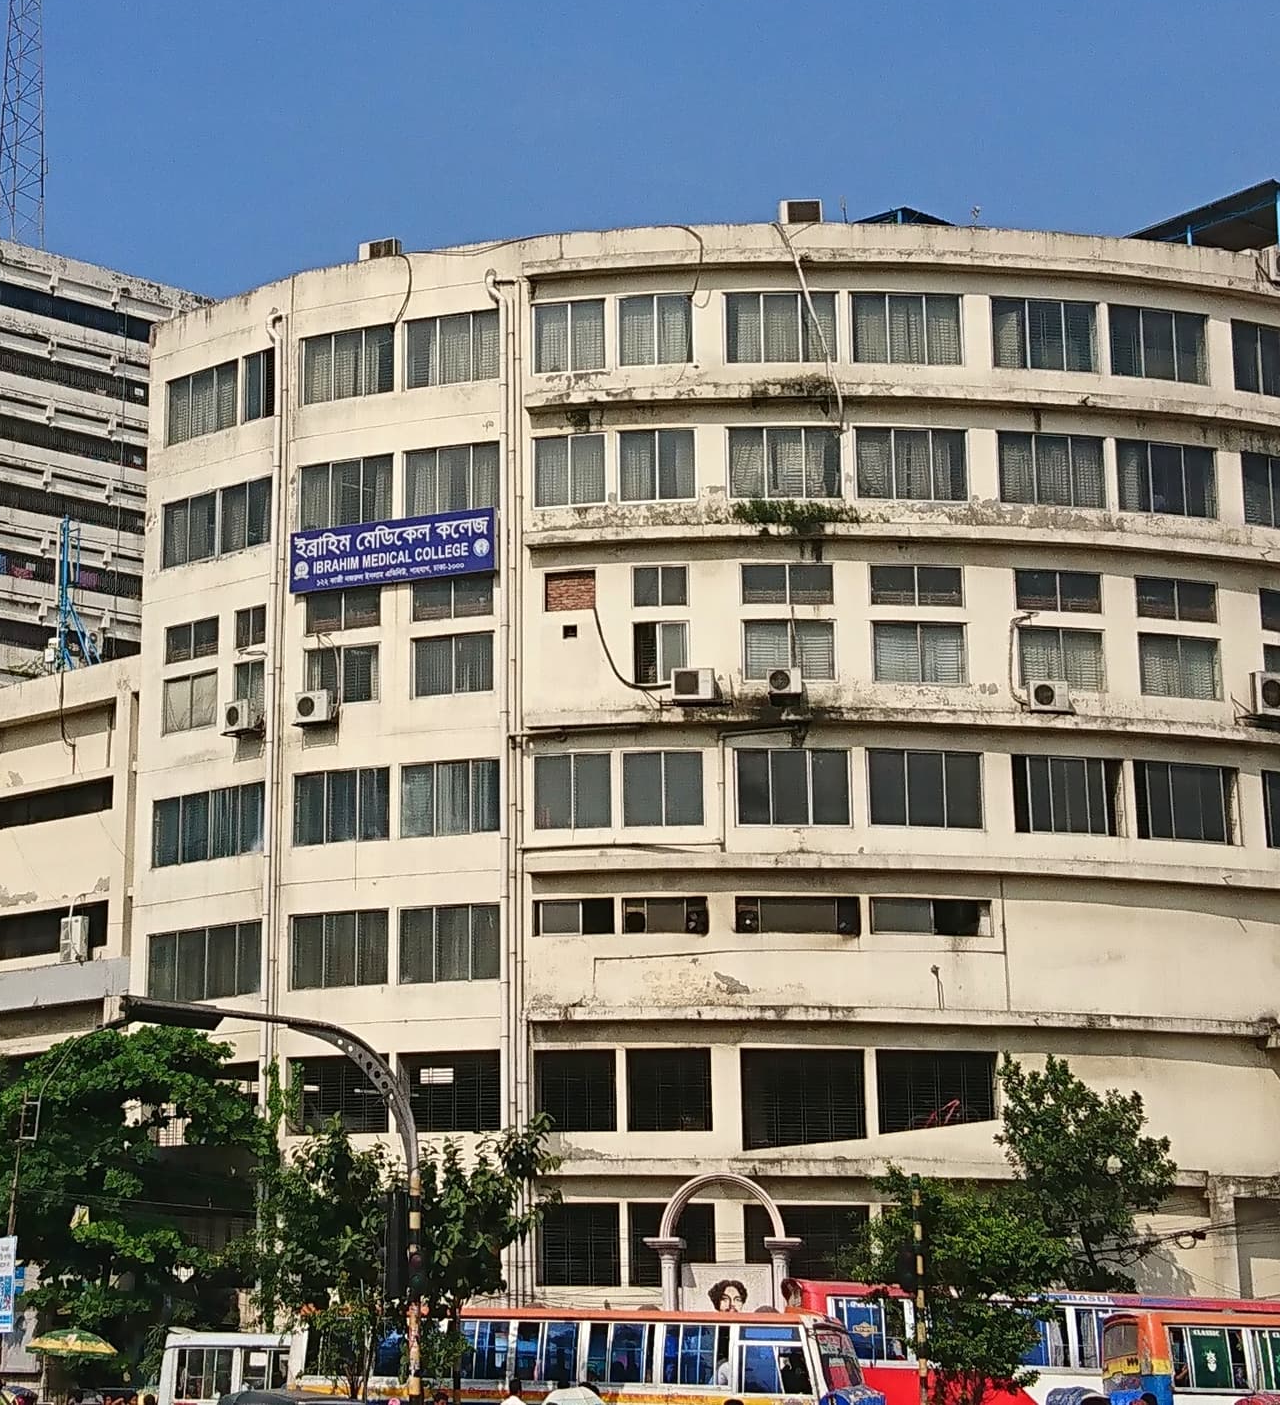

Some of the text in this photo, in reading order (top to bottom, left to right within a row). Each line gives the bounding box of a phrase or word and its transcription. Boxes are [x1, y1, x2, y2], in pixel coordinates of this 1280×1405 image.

[294, 517, 490, 558] ইব্রাহিম মেডিকেল কলেজ
[313, 542, 470, 575] IBRAHIM MEDICAL COLLEGE
[1192, 1329, 1220, 1337] CLASSIC
